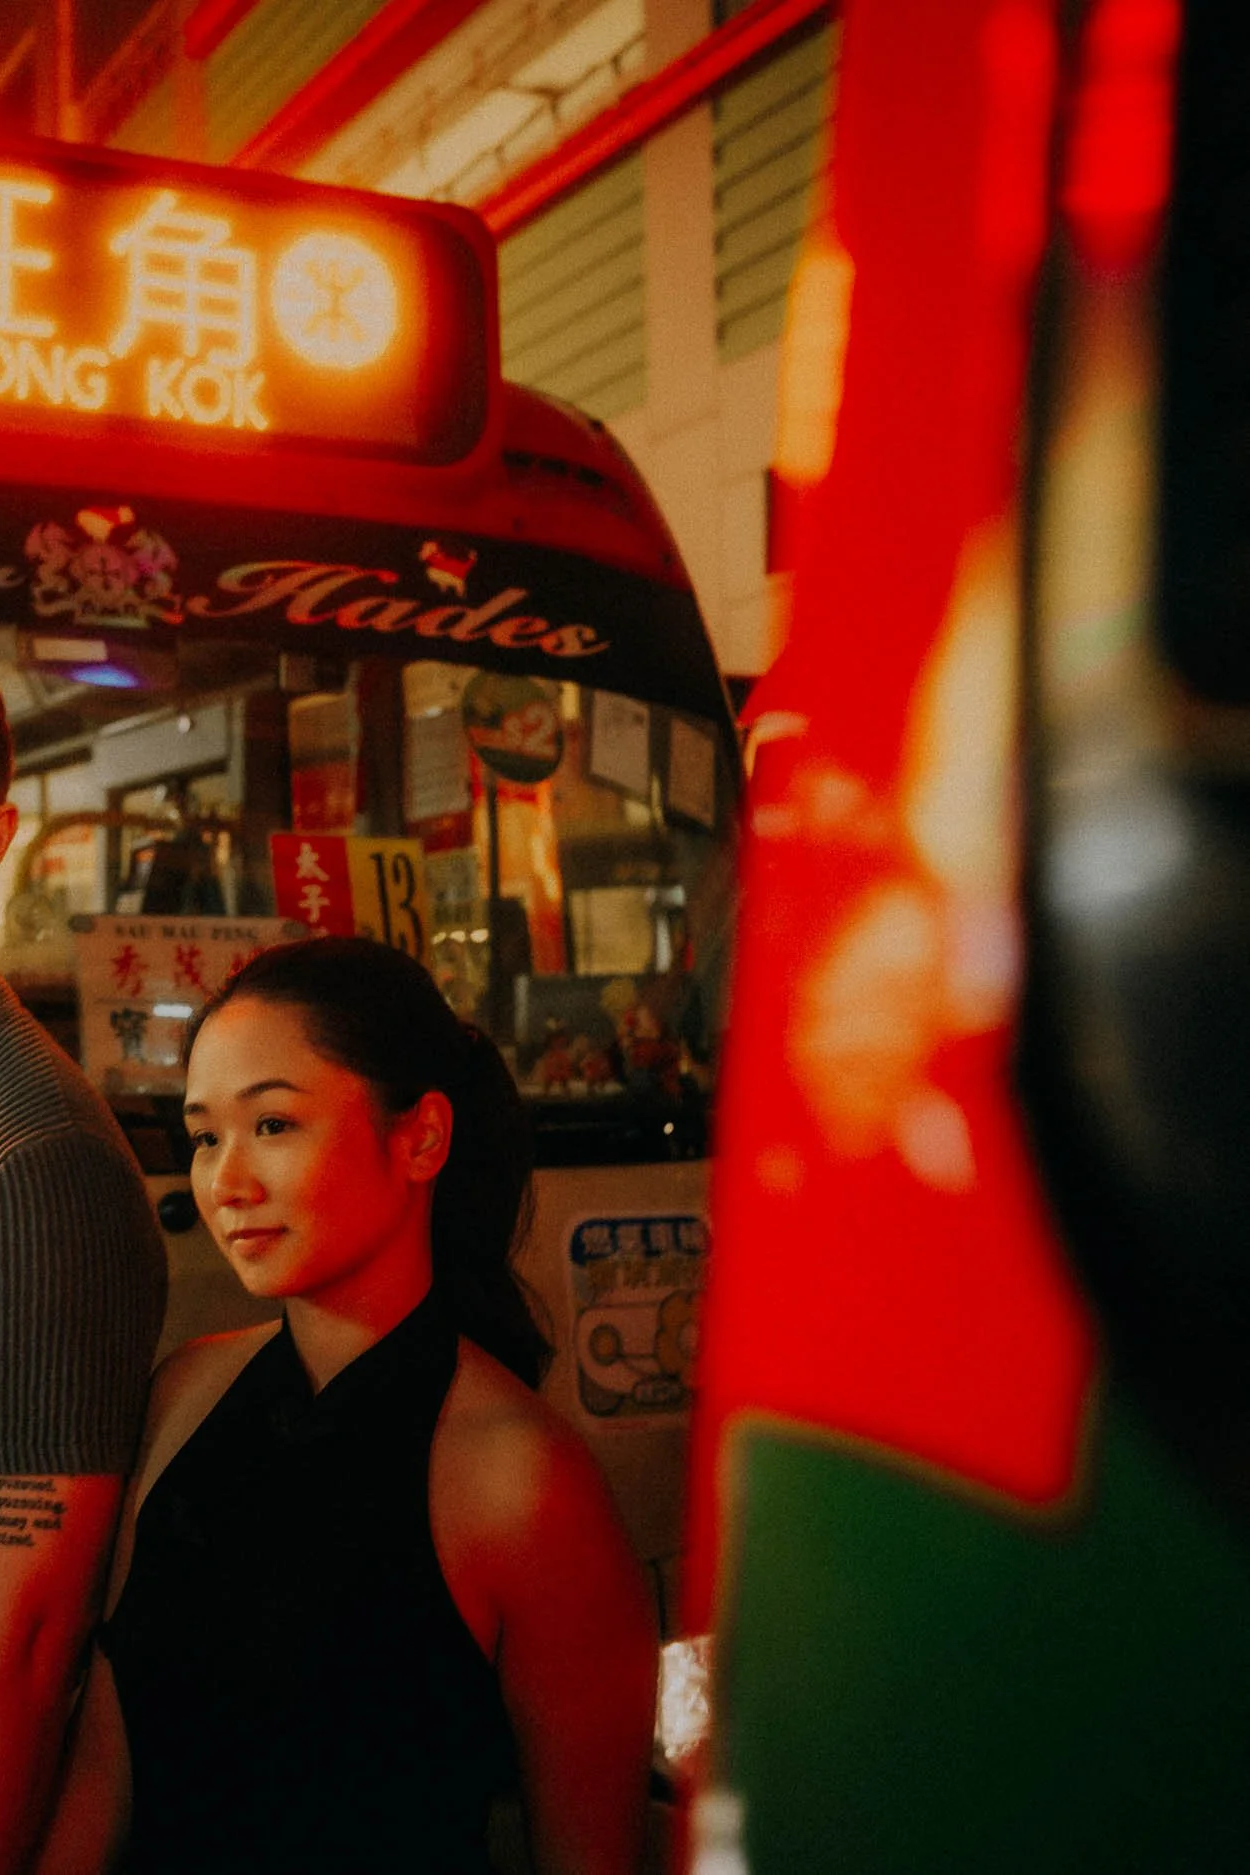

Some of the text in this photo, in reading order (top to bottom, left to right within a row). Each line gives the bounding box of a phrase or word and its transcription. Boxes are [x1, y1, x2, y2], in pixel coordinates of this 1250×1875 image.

[148, 354, 269, 431] KOK
[188, 560, 609, 658] Hades
[295, 842, 331, 937] 太子
[370, 852, 424, 958] 13
[111, 944, 253, 1000] 秀茂
